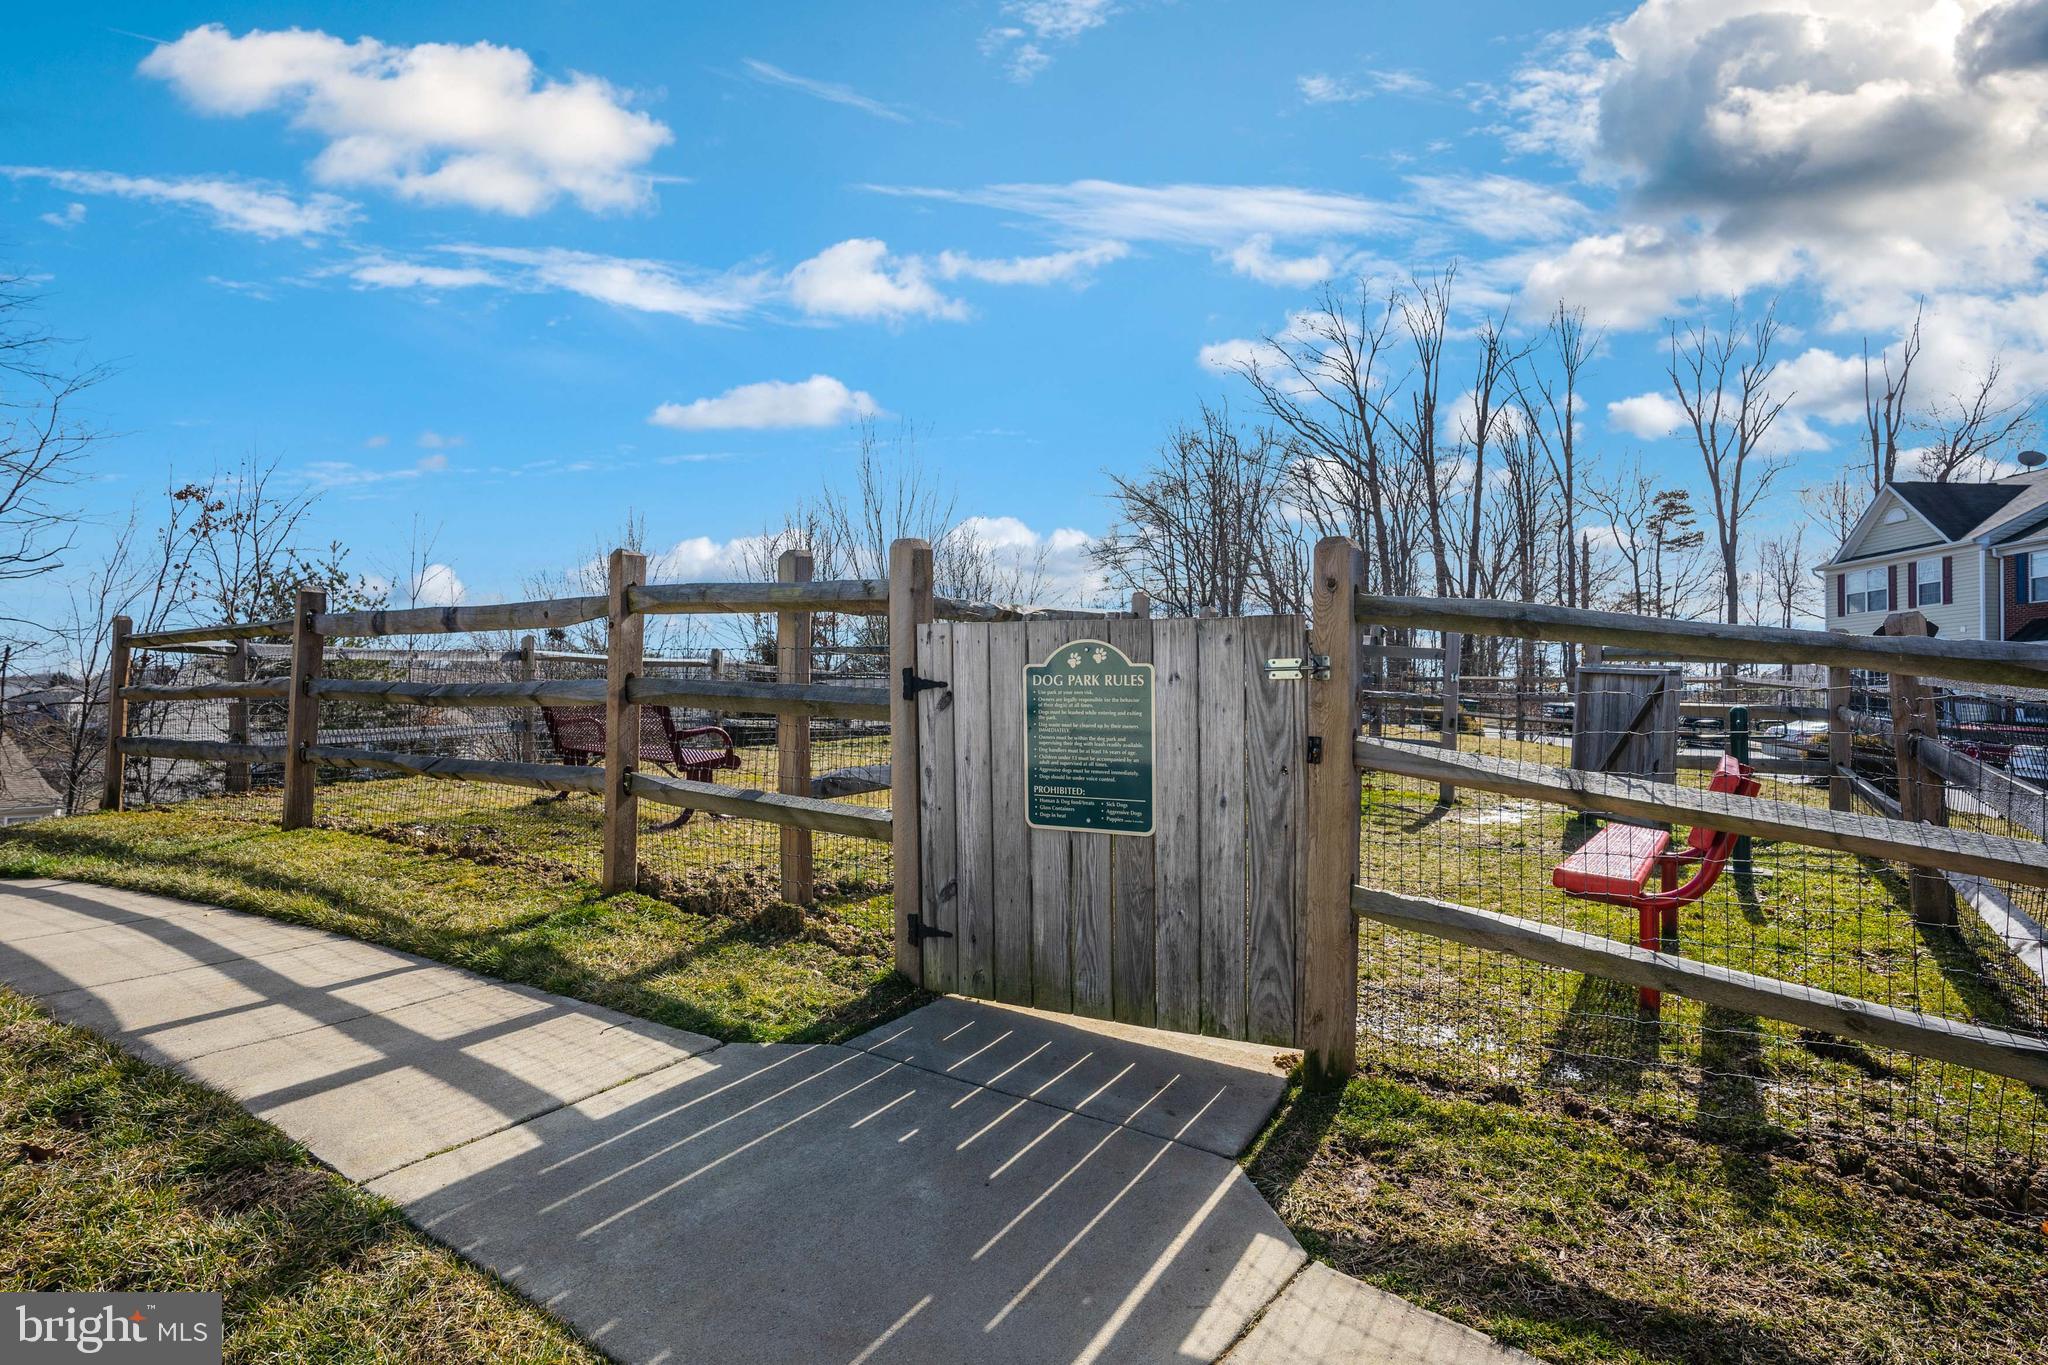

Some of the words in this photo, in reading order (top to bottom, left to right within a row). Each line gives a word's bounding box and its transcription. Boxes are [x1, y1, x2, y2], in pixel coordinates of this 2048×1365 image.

[1033, 675, 1063, 686] DOG
[1068, 674, 1100, 686] PARK
[1105, 674, 1144, 686] RULES
[1033, 785, 1086, 795] PROHIBITED:
